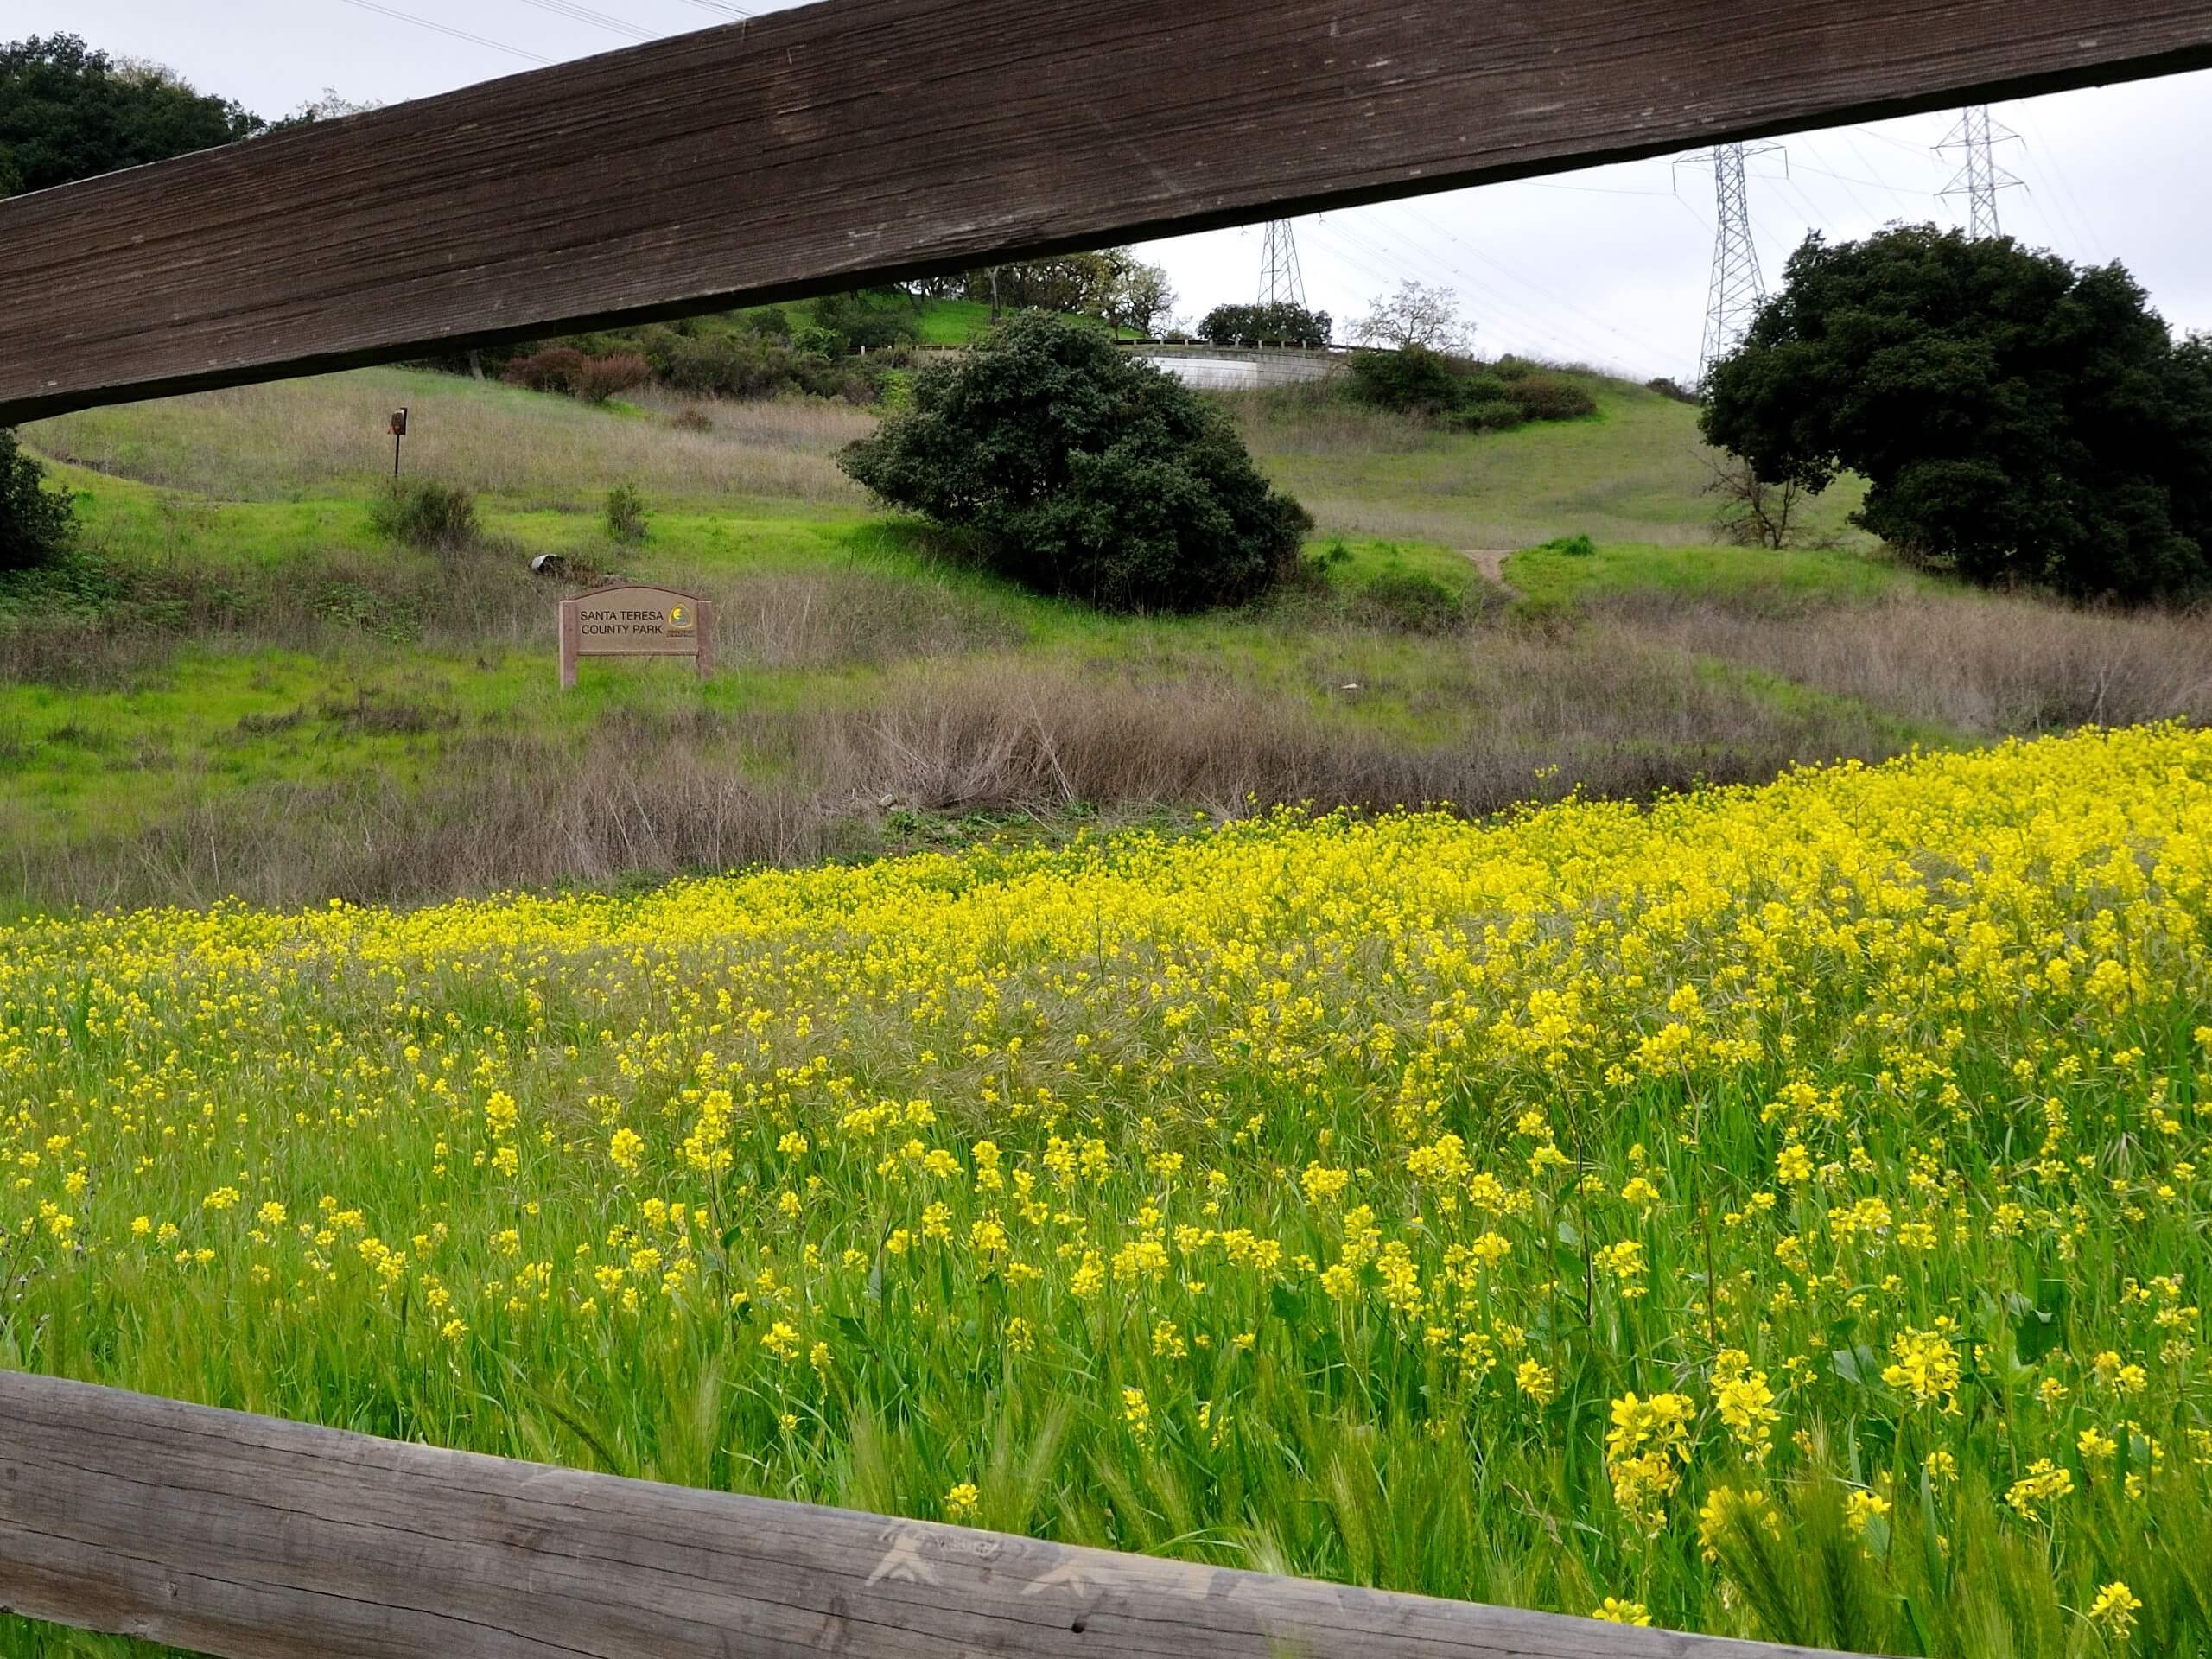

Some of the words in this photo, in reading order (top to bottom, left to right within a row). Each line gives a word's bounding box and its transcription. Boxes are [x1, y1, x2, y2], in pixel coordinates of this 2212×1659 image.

[581, 611, 617, 620] SANTA
[620, 611, 664, 620] TERESA
[582, 625, 629, 634] COUNTY
[633, 625, 663, 634] PARK
